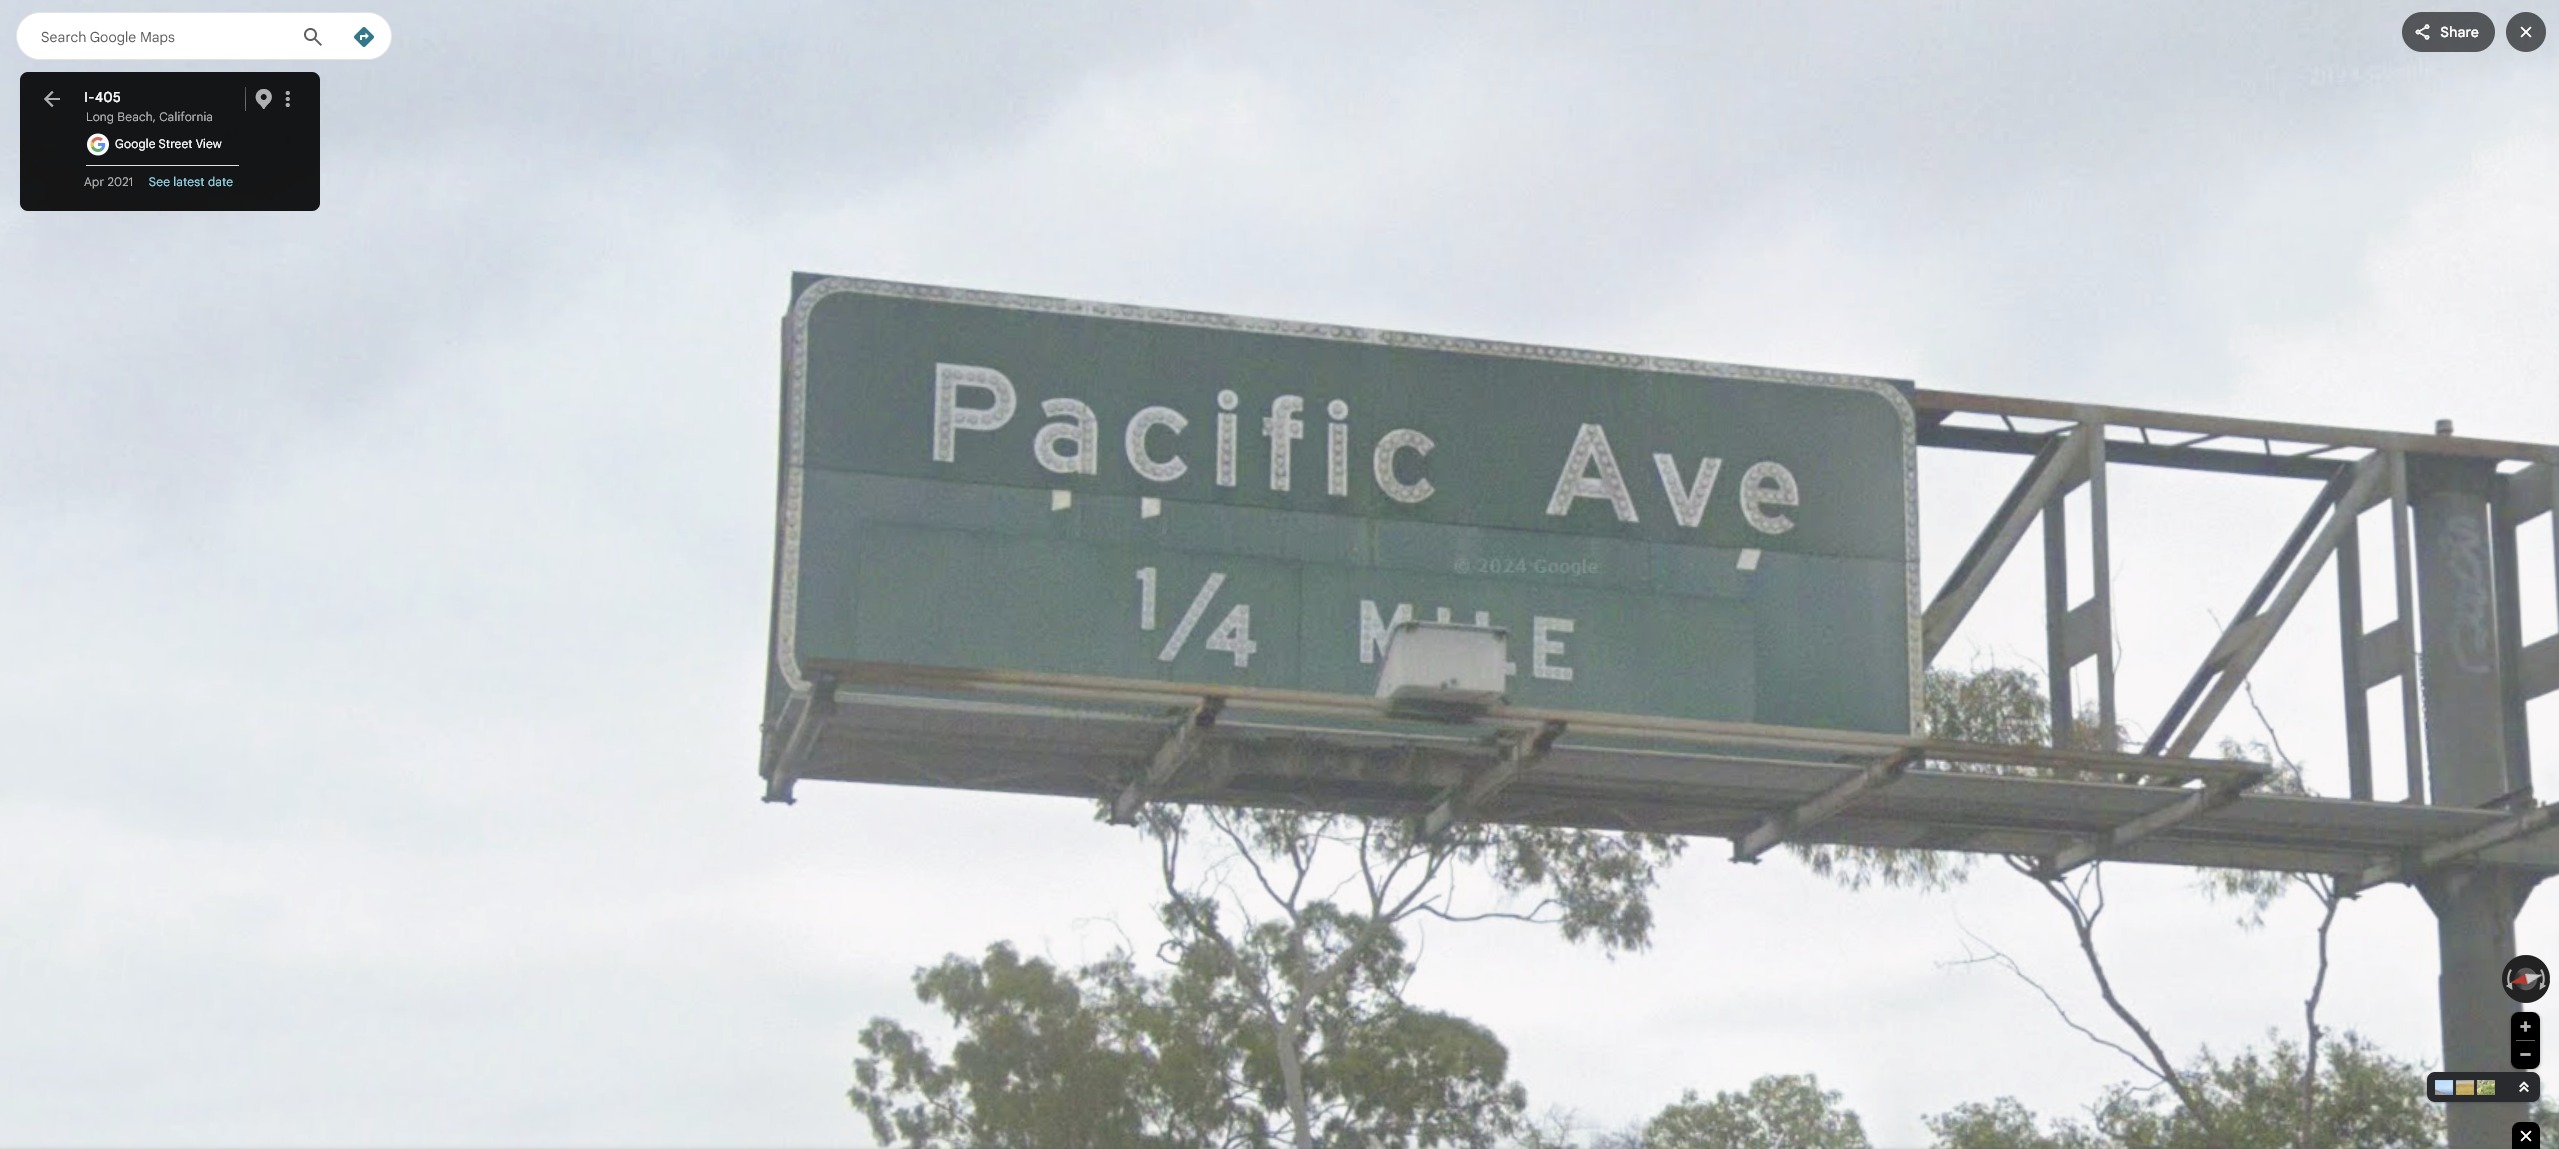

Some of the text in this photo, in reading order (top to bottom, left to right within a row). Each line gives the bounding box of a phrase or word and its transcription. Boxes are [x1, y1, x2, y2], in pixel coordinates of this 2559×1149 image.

[933, 362, 1799, 535] Pacific Ave
[1136, 567, 1576, 681] 1/4 ME
